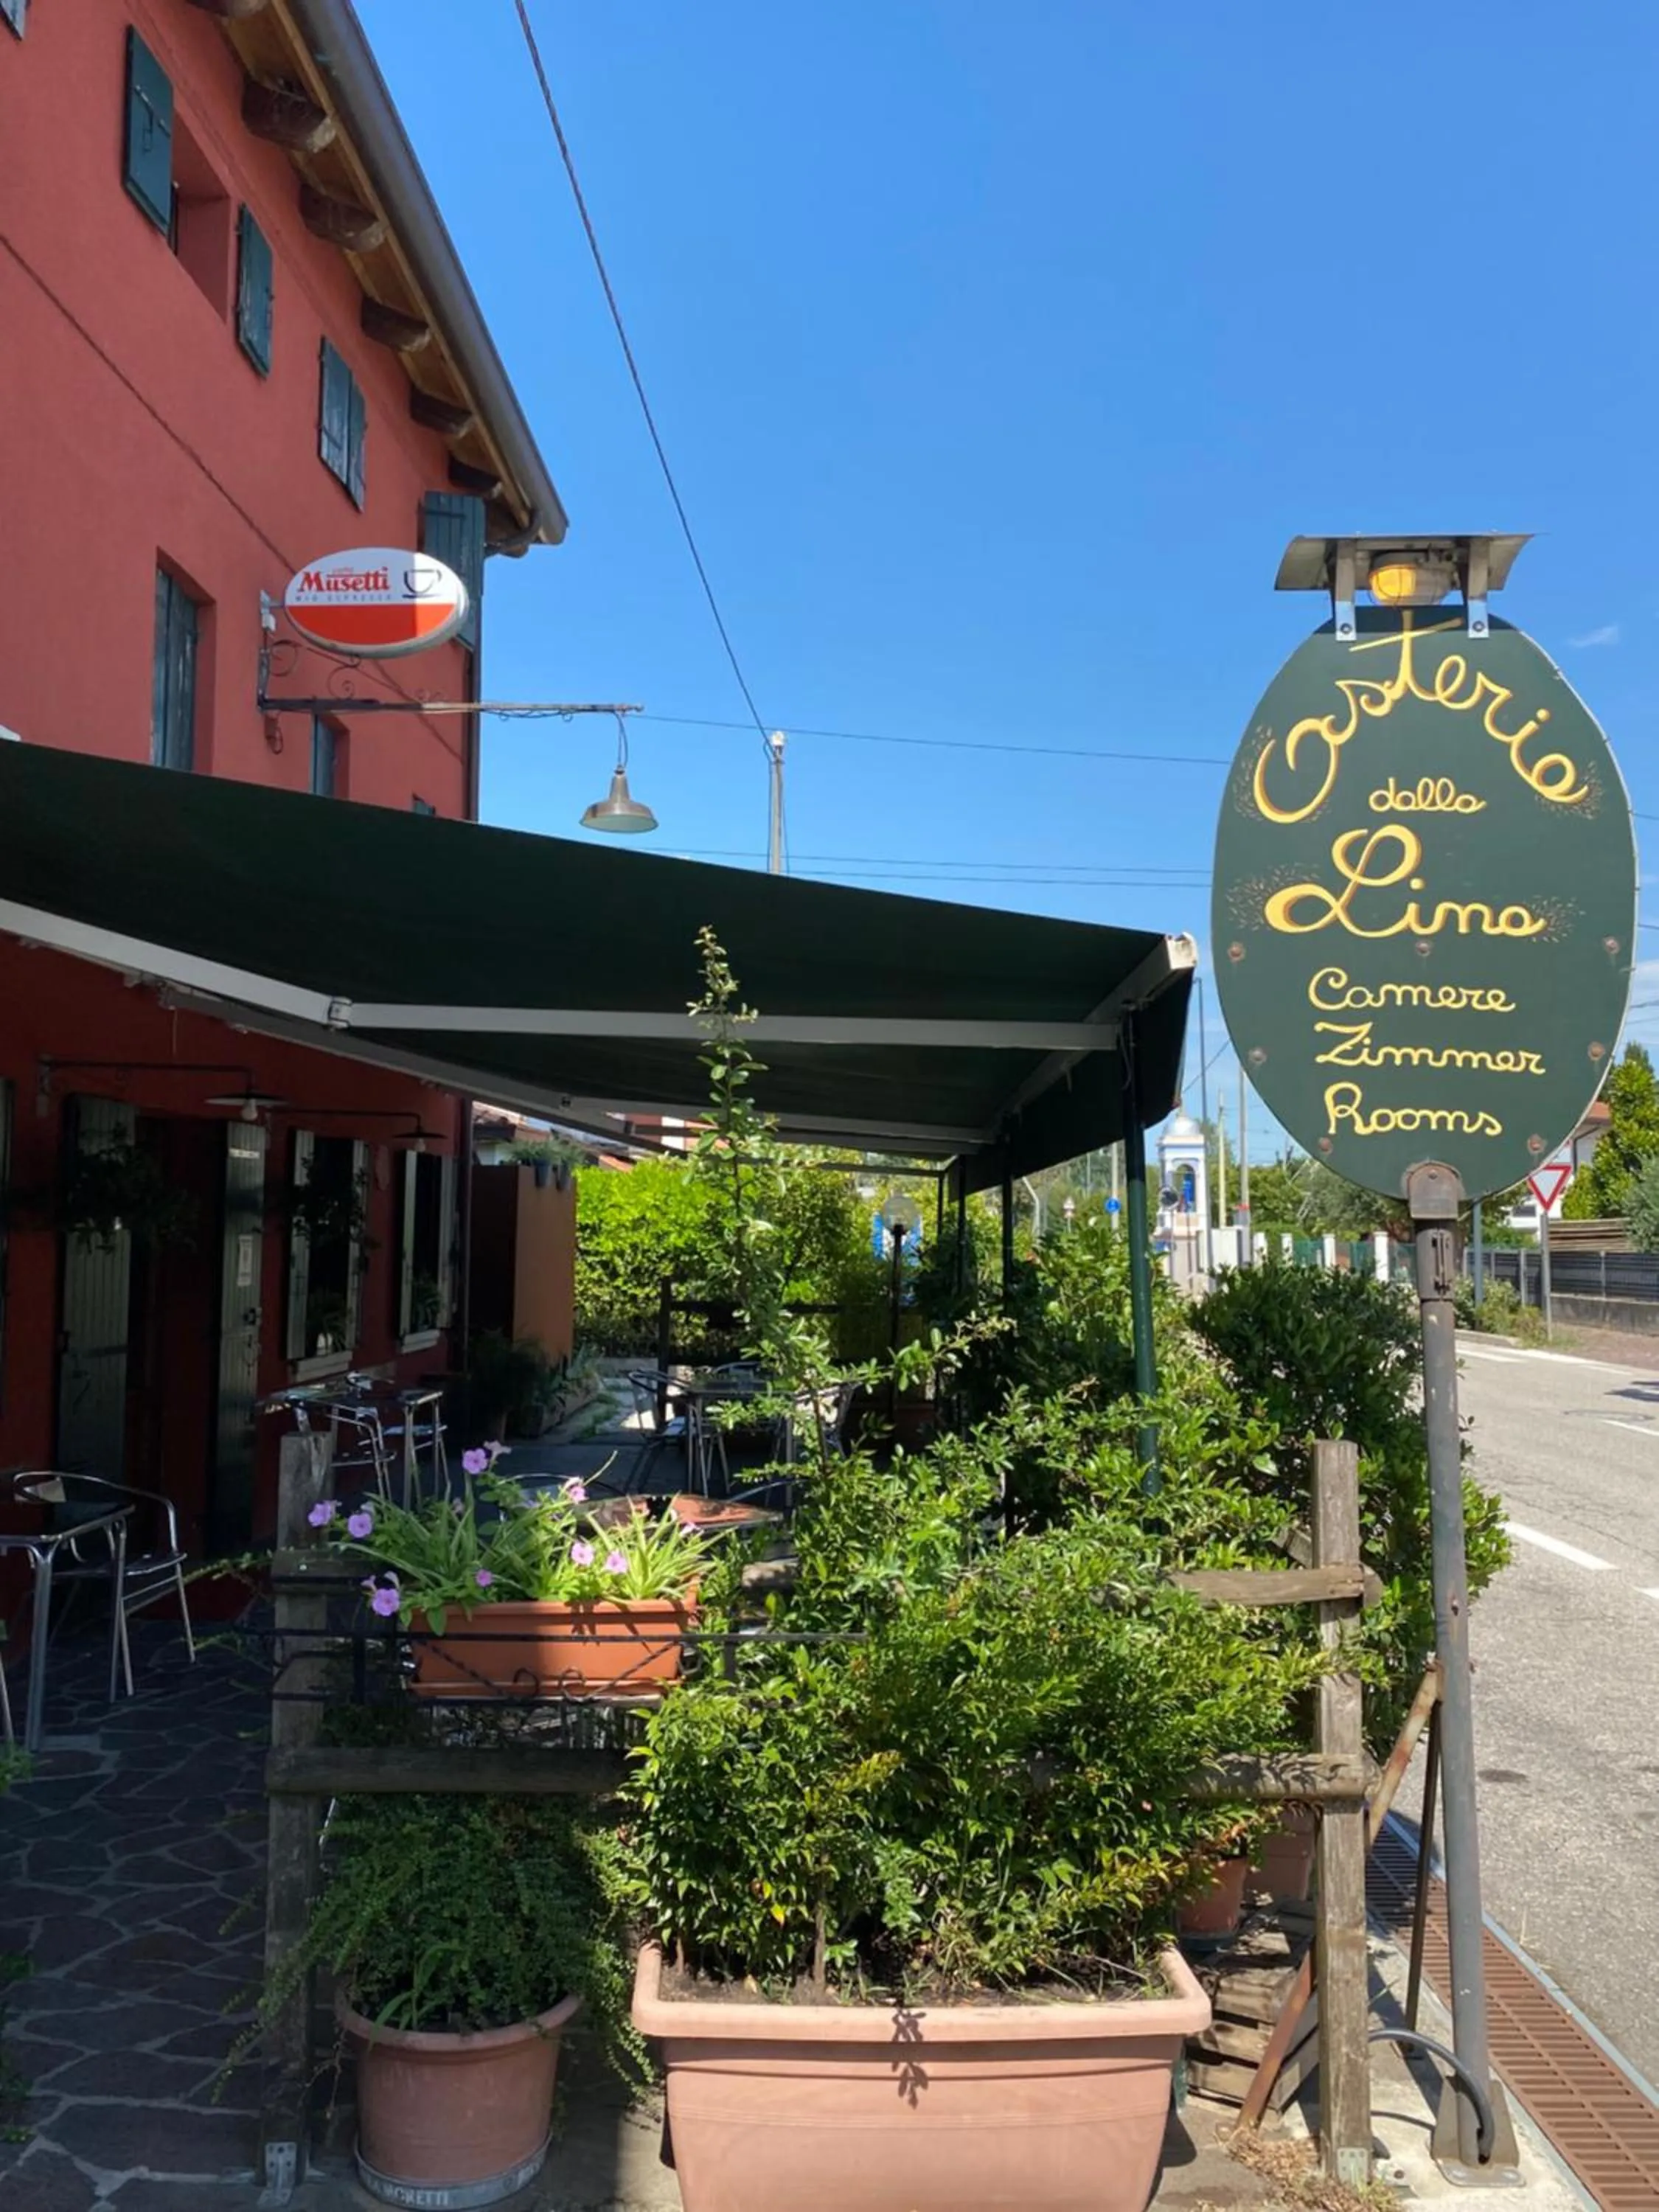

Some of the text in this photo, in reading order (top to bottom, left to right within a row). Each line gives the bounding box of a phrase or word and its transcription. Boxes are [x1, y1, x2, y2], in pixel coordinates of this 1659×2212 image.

[298, 566, 390, 592] Musetti
[1253, 608, 1589, 824] Osteria
[1264, 823, 1547, 938] Lina
[1307, 967, 1516, 1011] Camere
[1313, 1021, 1546, 1075] Zimmer
[1324, 1082, 1503, 1137] Rooms
